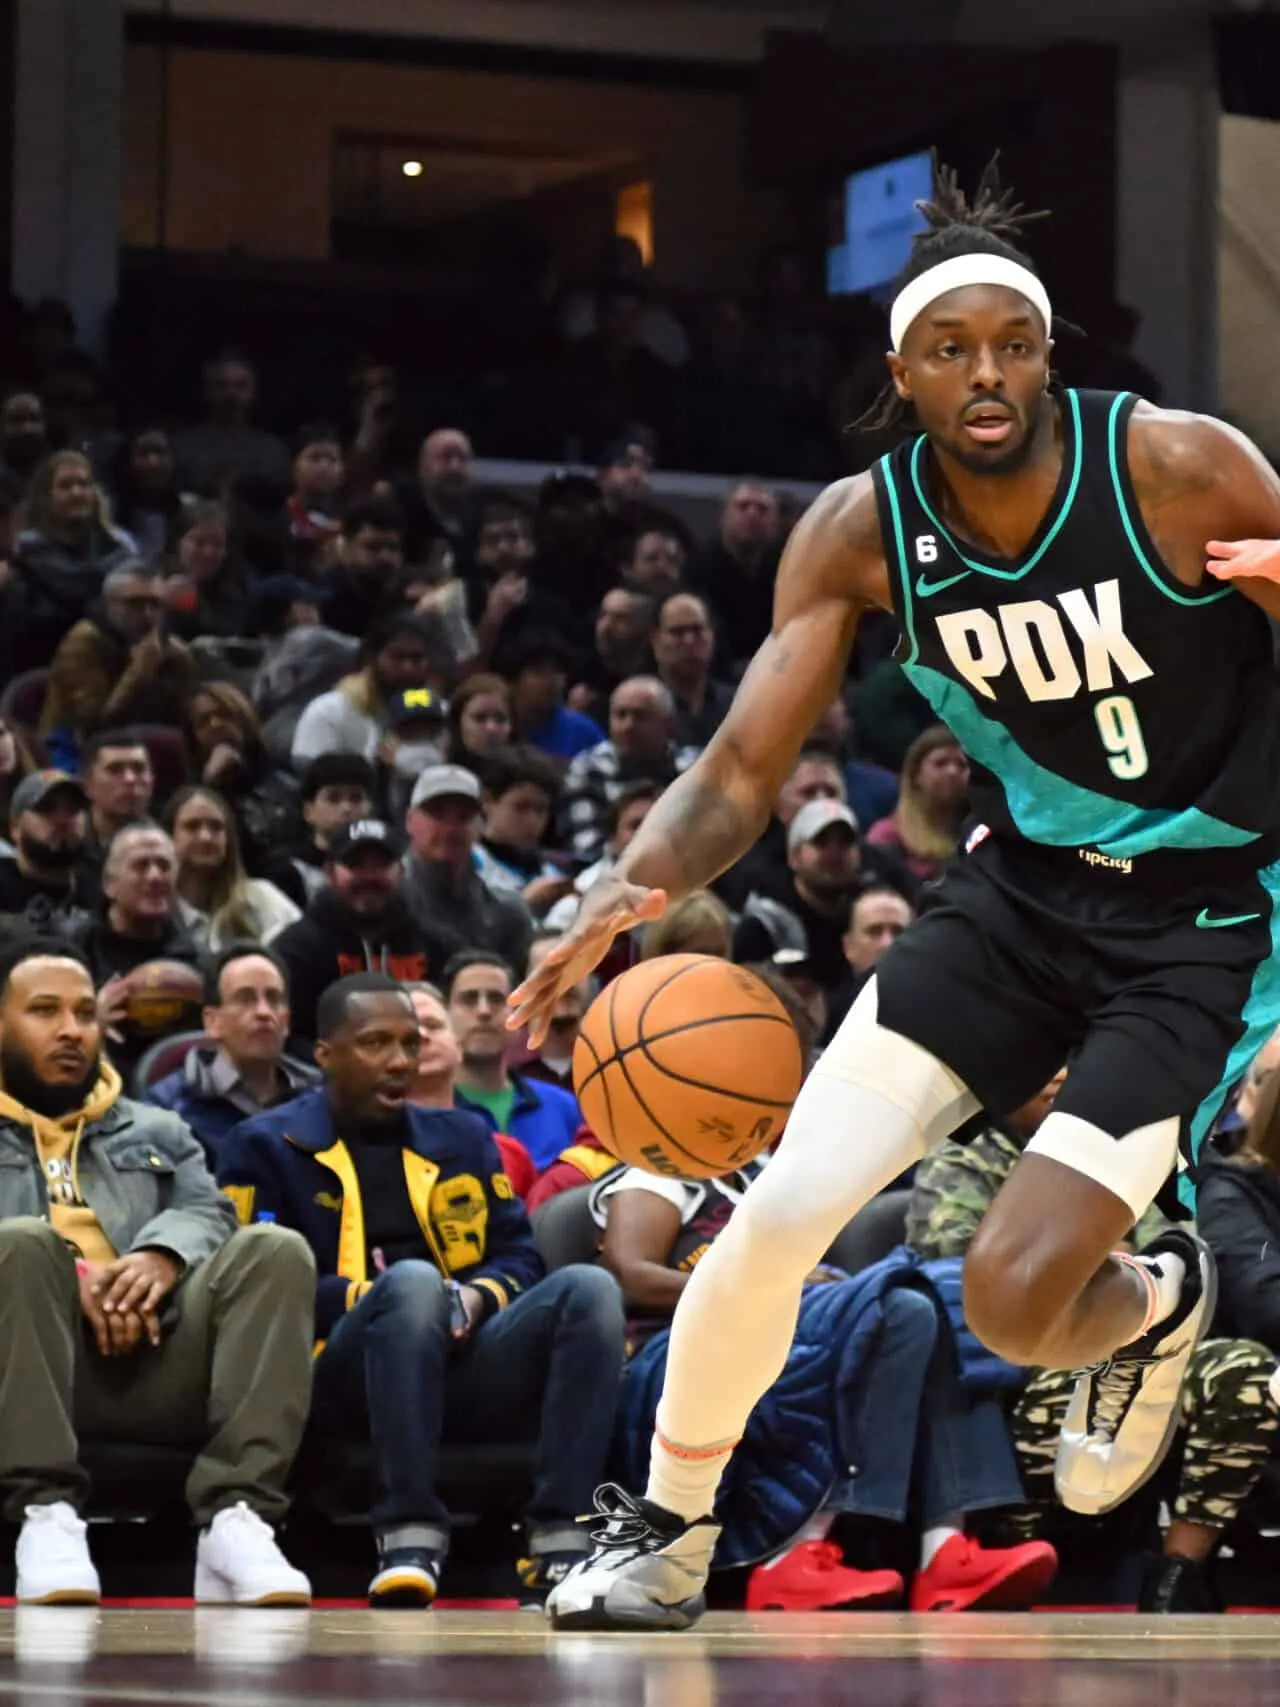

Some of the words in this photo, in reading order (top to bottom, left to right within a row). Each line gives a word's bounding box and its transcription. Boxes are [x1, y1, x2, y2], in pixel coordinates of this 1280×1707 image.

[915, 535, 938, 563] 6
[934, 578, 1155, 702] PDX
[1094, 695, 1149, 780] 9
[1079, 848, 1133, 874] ripcity
